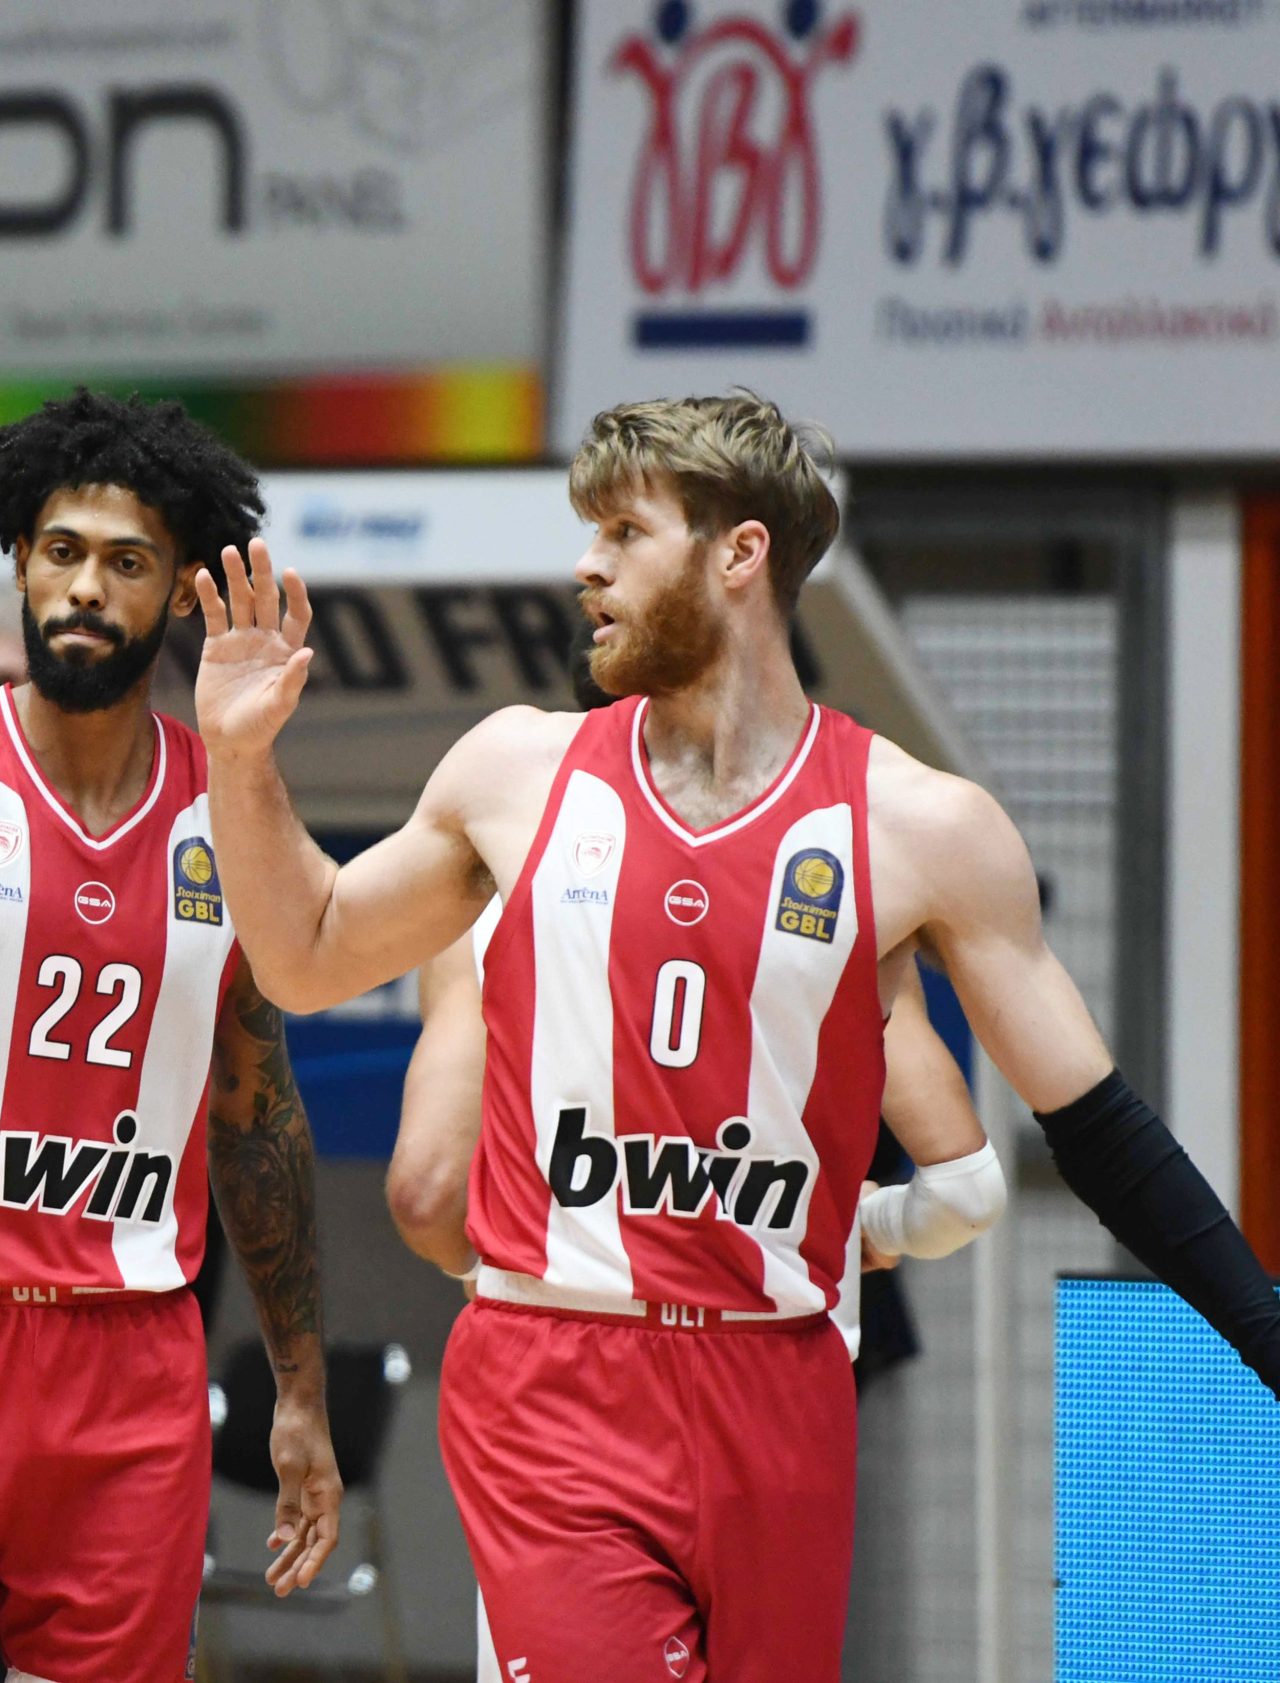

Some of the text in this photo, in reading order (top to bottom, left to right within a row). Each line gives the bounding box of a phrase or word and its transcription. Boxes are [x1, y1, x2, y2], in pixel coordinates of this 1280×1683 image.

[178, 899, 220, 922] GBL
[780, 910, 831, 940] GBL
[28, 953, 143, 1069] 22
[649, 958, 707, 1069] 0
[546, 1101, 820, 1232] bwin
